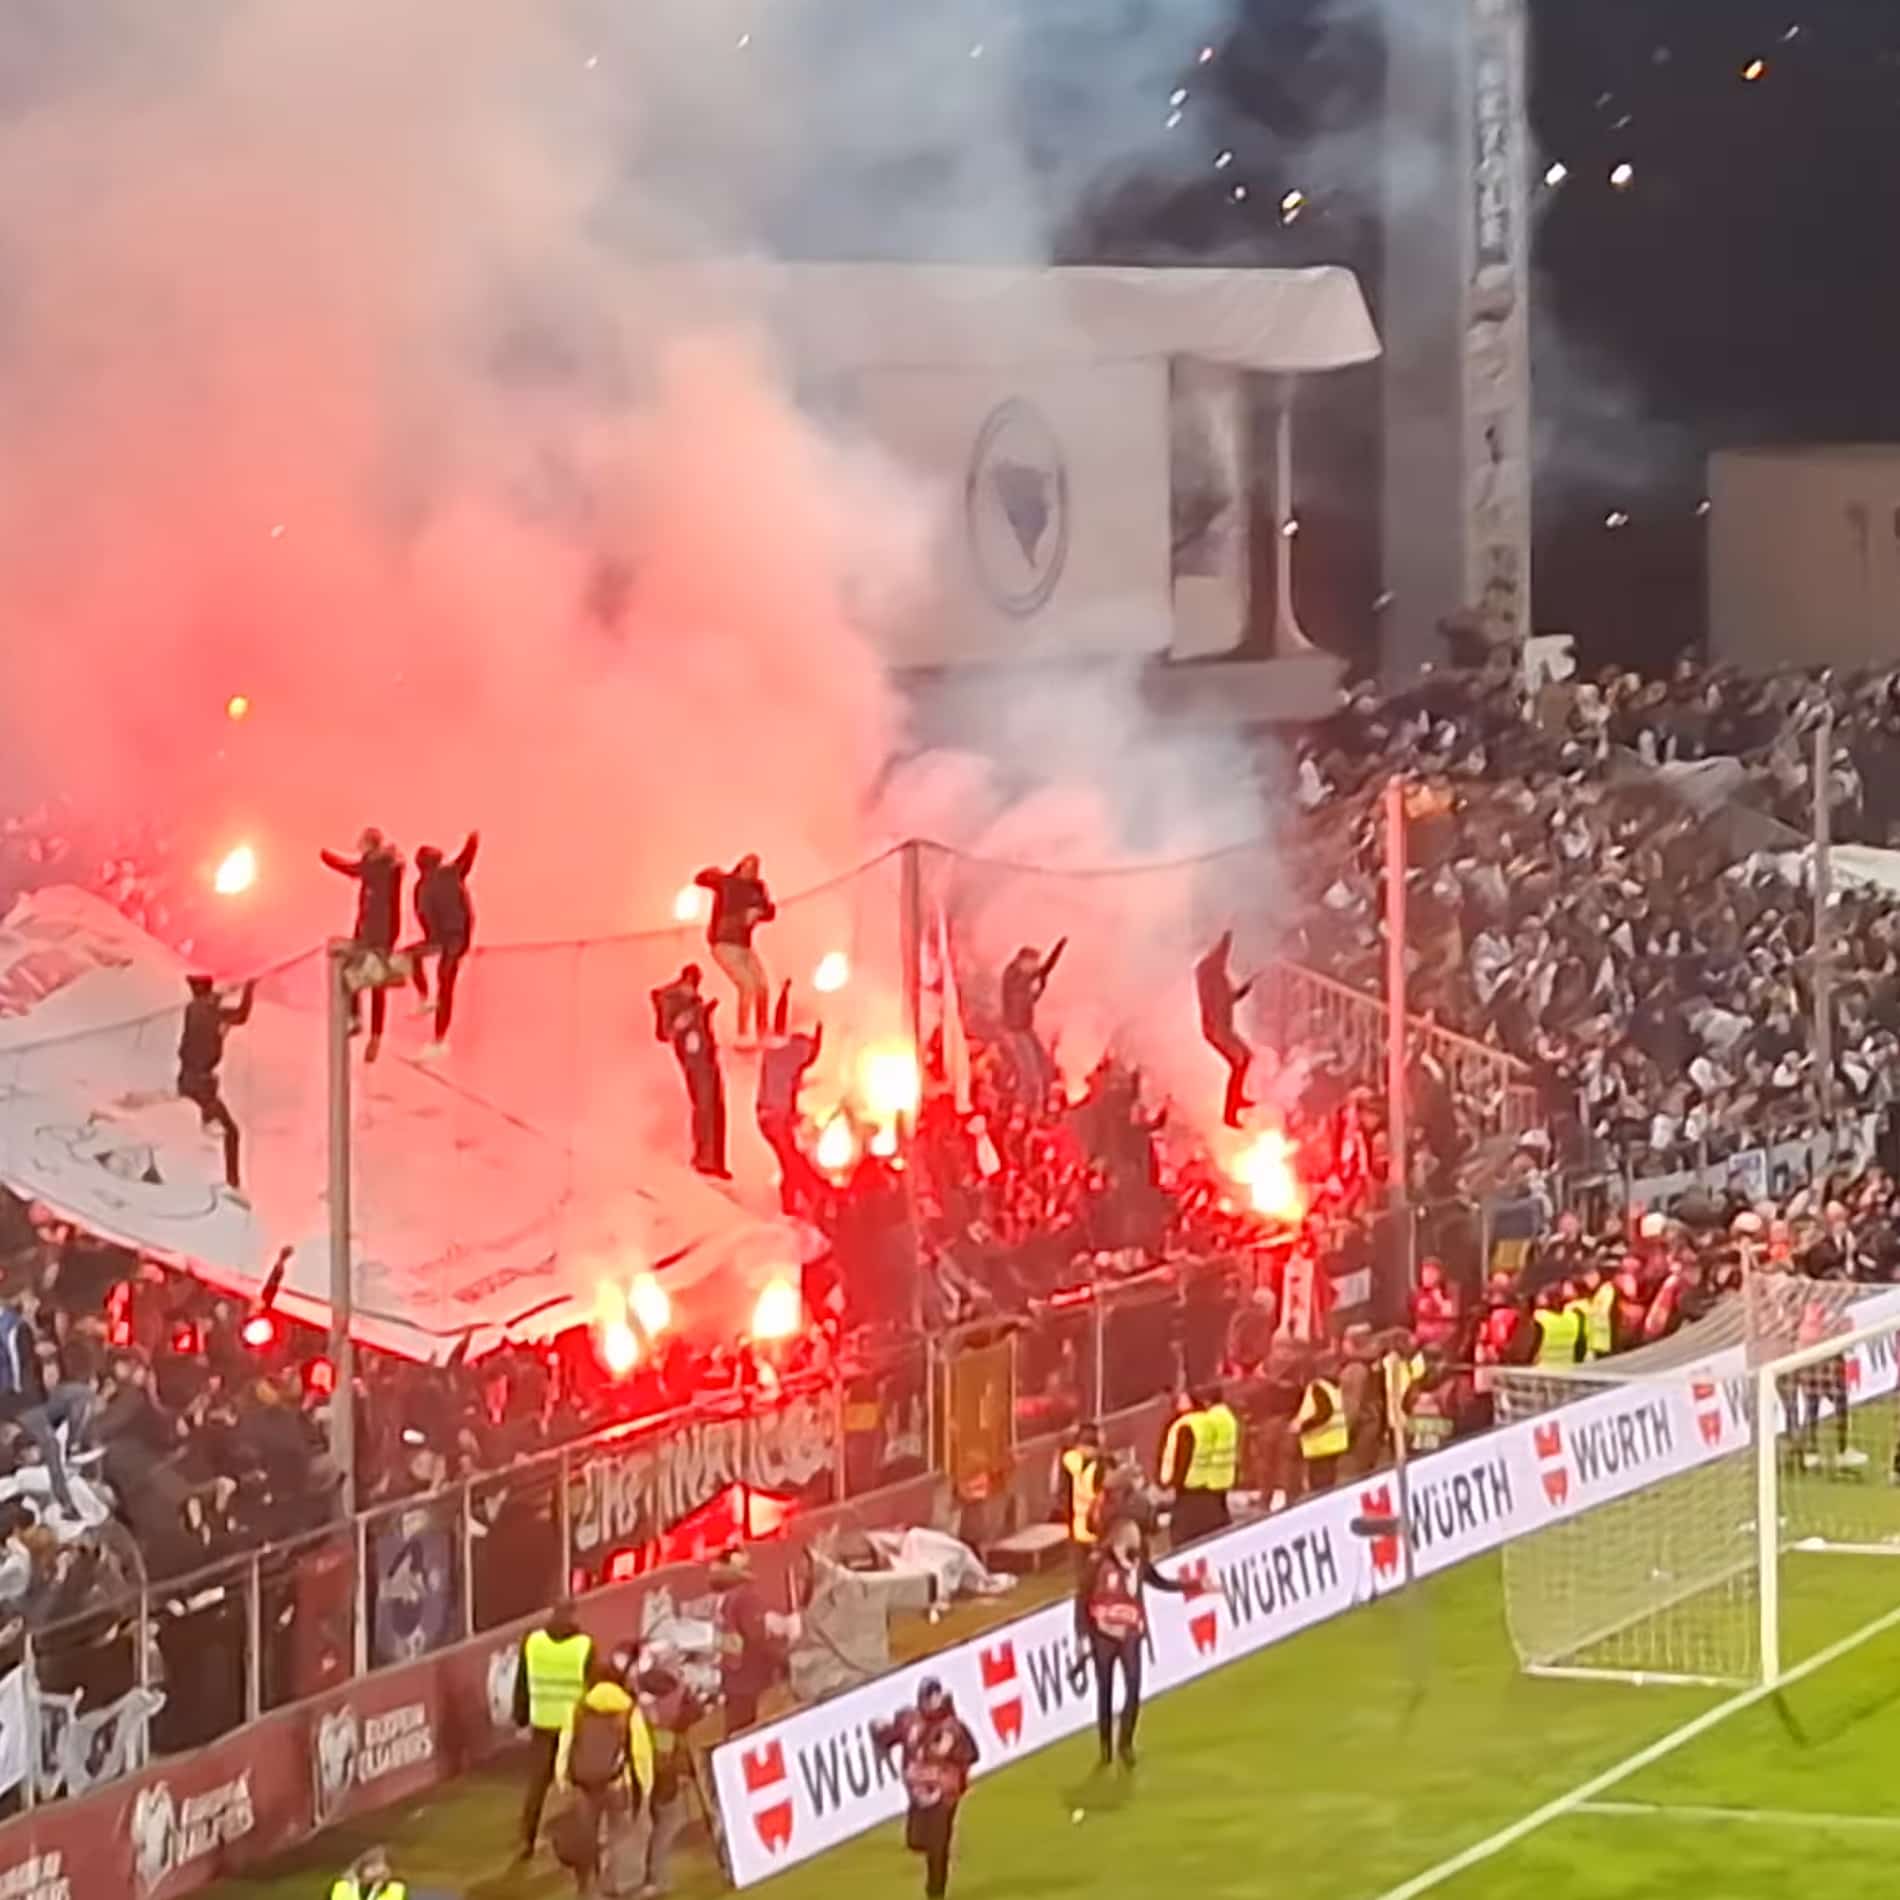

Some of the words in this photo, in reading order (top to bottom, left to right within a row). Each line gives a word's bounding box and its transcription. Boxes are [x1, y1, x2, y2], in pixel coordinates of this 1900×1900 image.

[1570, 1397, 1673, 1483] WÜRTH
[1411, 1457, 1513, 1550] WÜRTH
[1220, 1526, 1338, 1628] WÜRTH
[798, 1720, 898, 1819] WÜR
